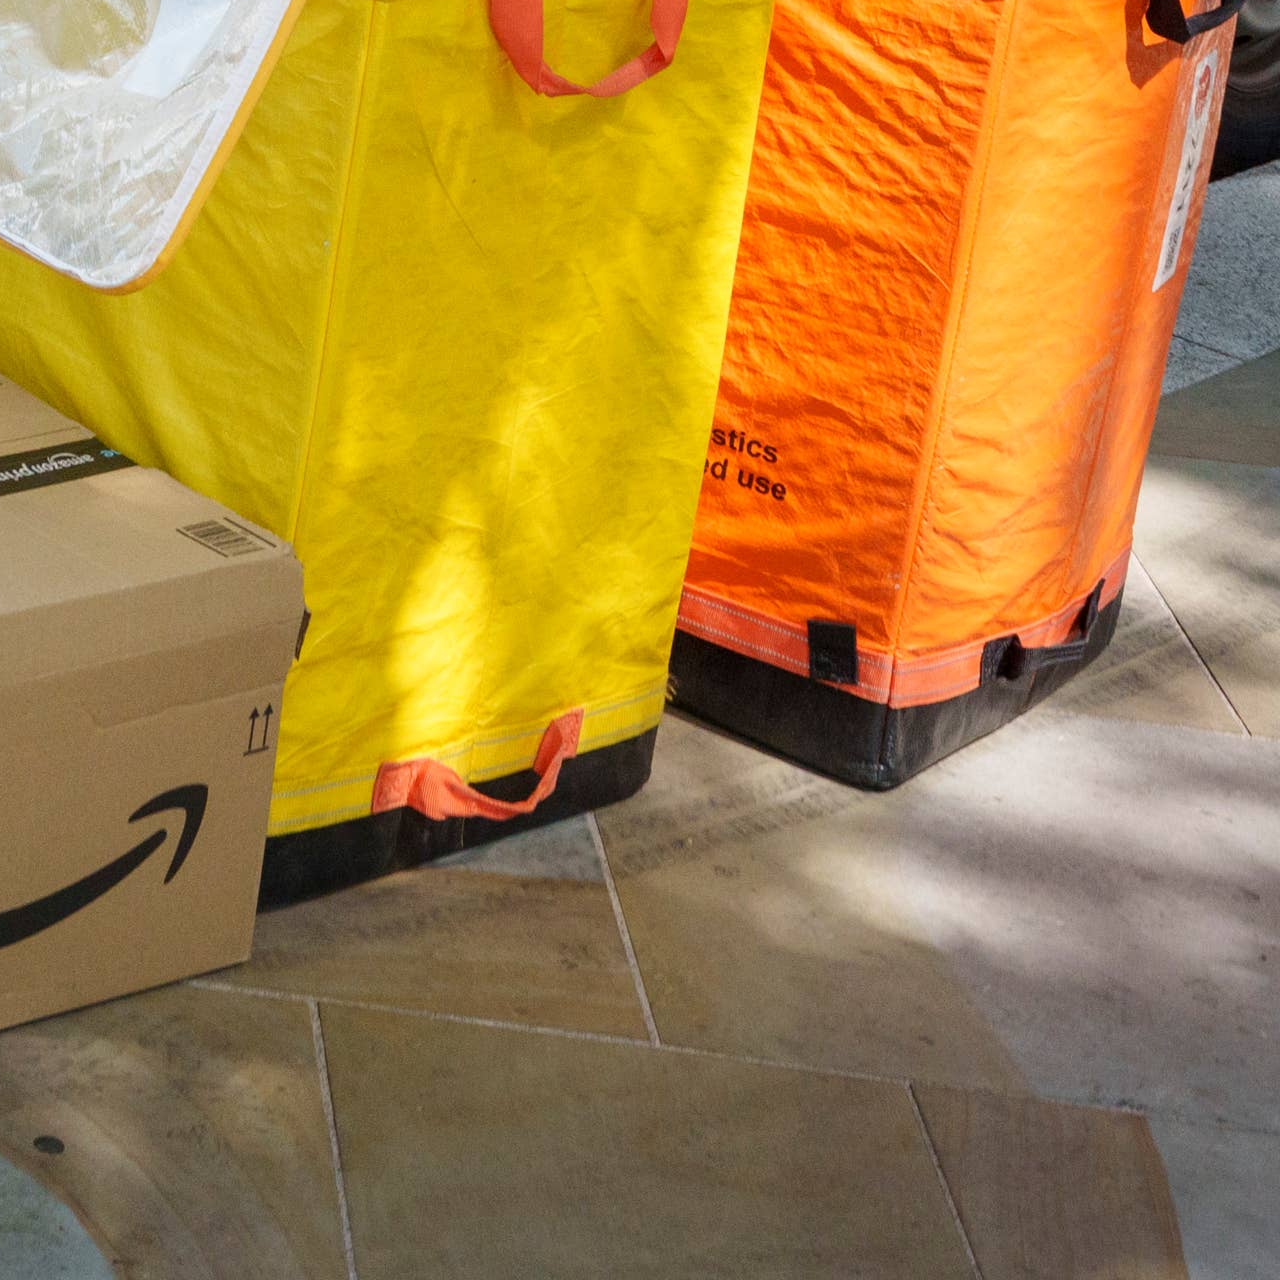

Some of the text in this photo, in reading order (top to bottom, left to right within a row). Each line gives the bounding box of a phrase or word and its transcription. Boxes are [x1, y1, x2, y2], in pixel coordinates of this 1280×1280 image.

[711, 428, 778, 464] stics
[32, 452, 95, 475] amazon
[737, 469, 787, 501] use
